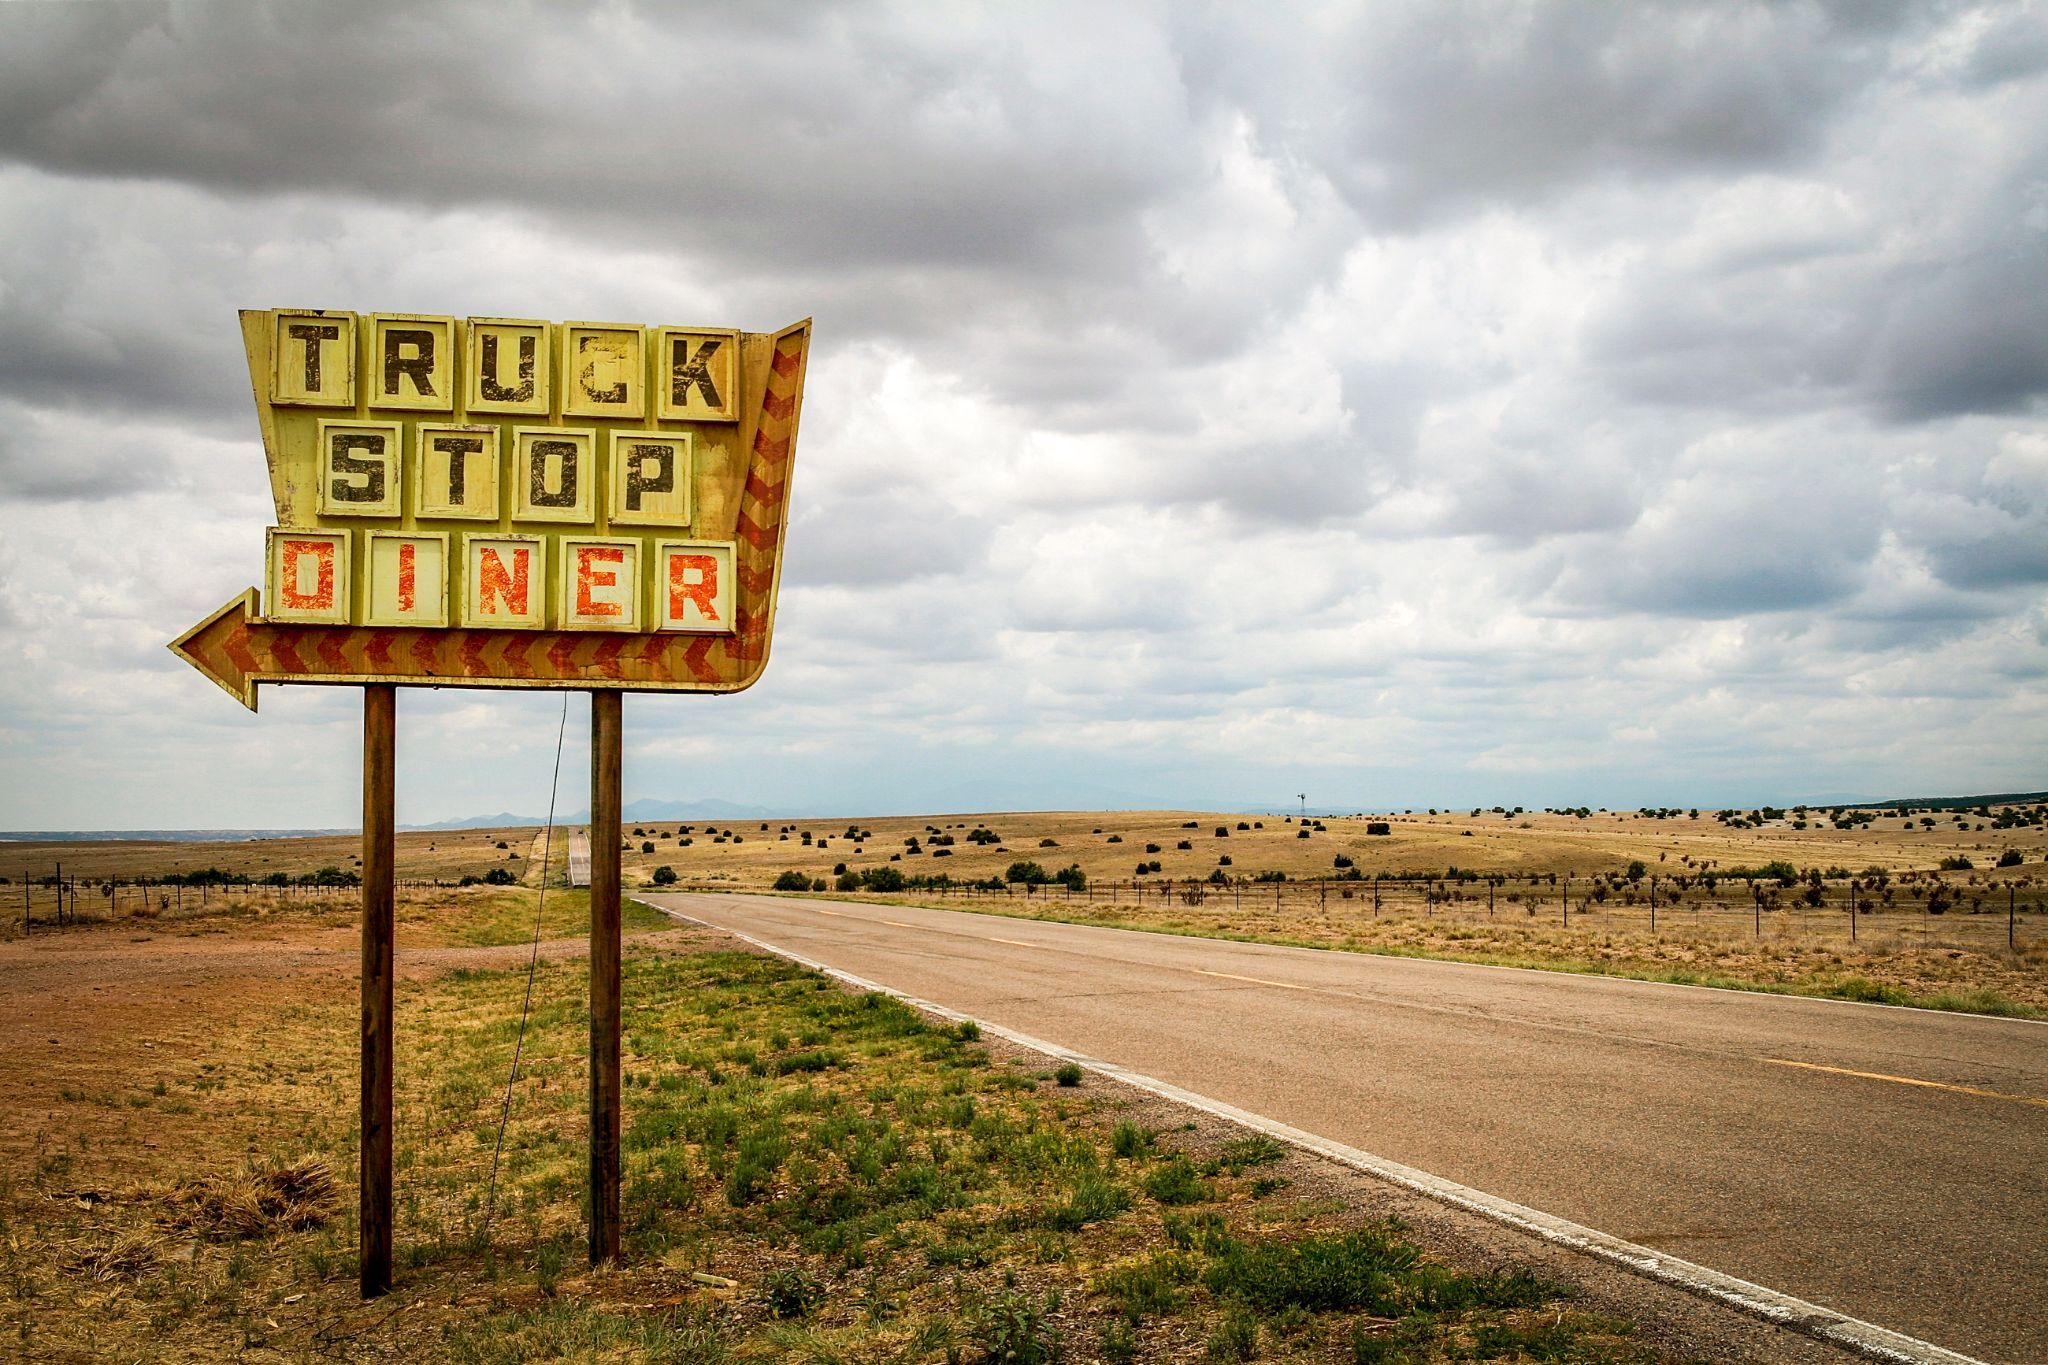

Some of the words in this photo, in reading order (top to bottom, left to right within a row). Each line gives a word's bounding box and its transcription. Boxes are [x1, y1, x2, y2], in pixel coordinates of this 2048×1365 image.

[288, 324, 723, 407] TRUCK
[331, 433, 675, 511] STOP
[281, 540, 721, 621] DINER
